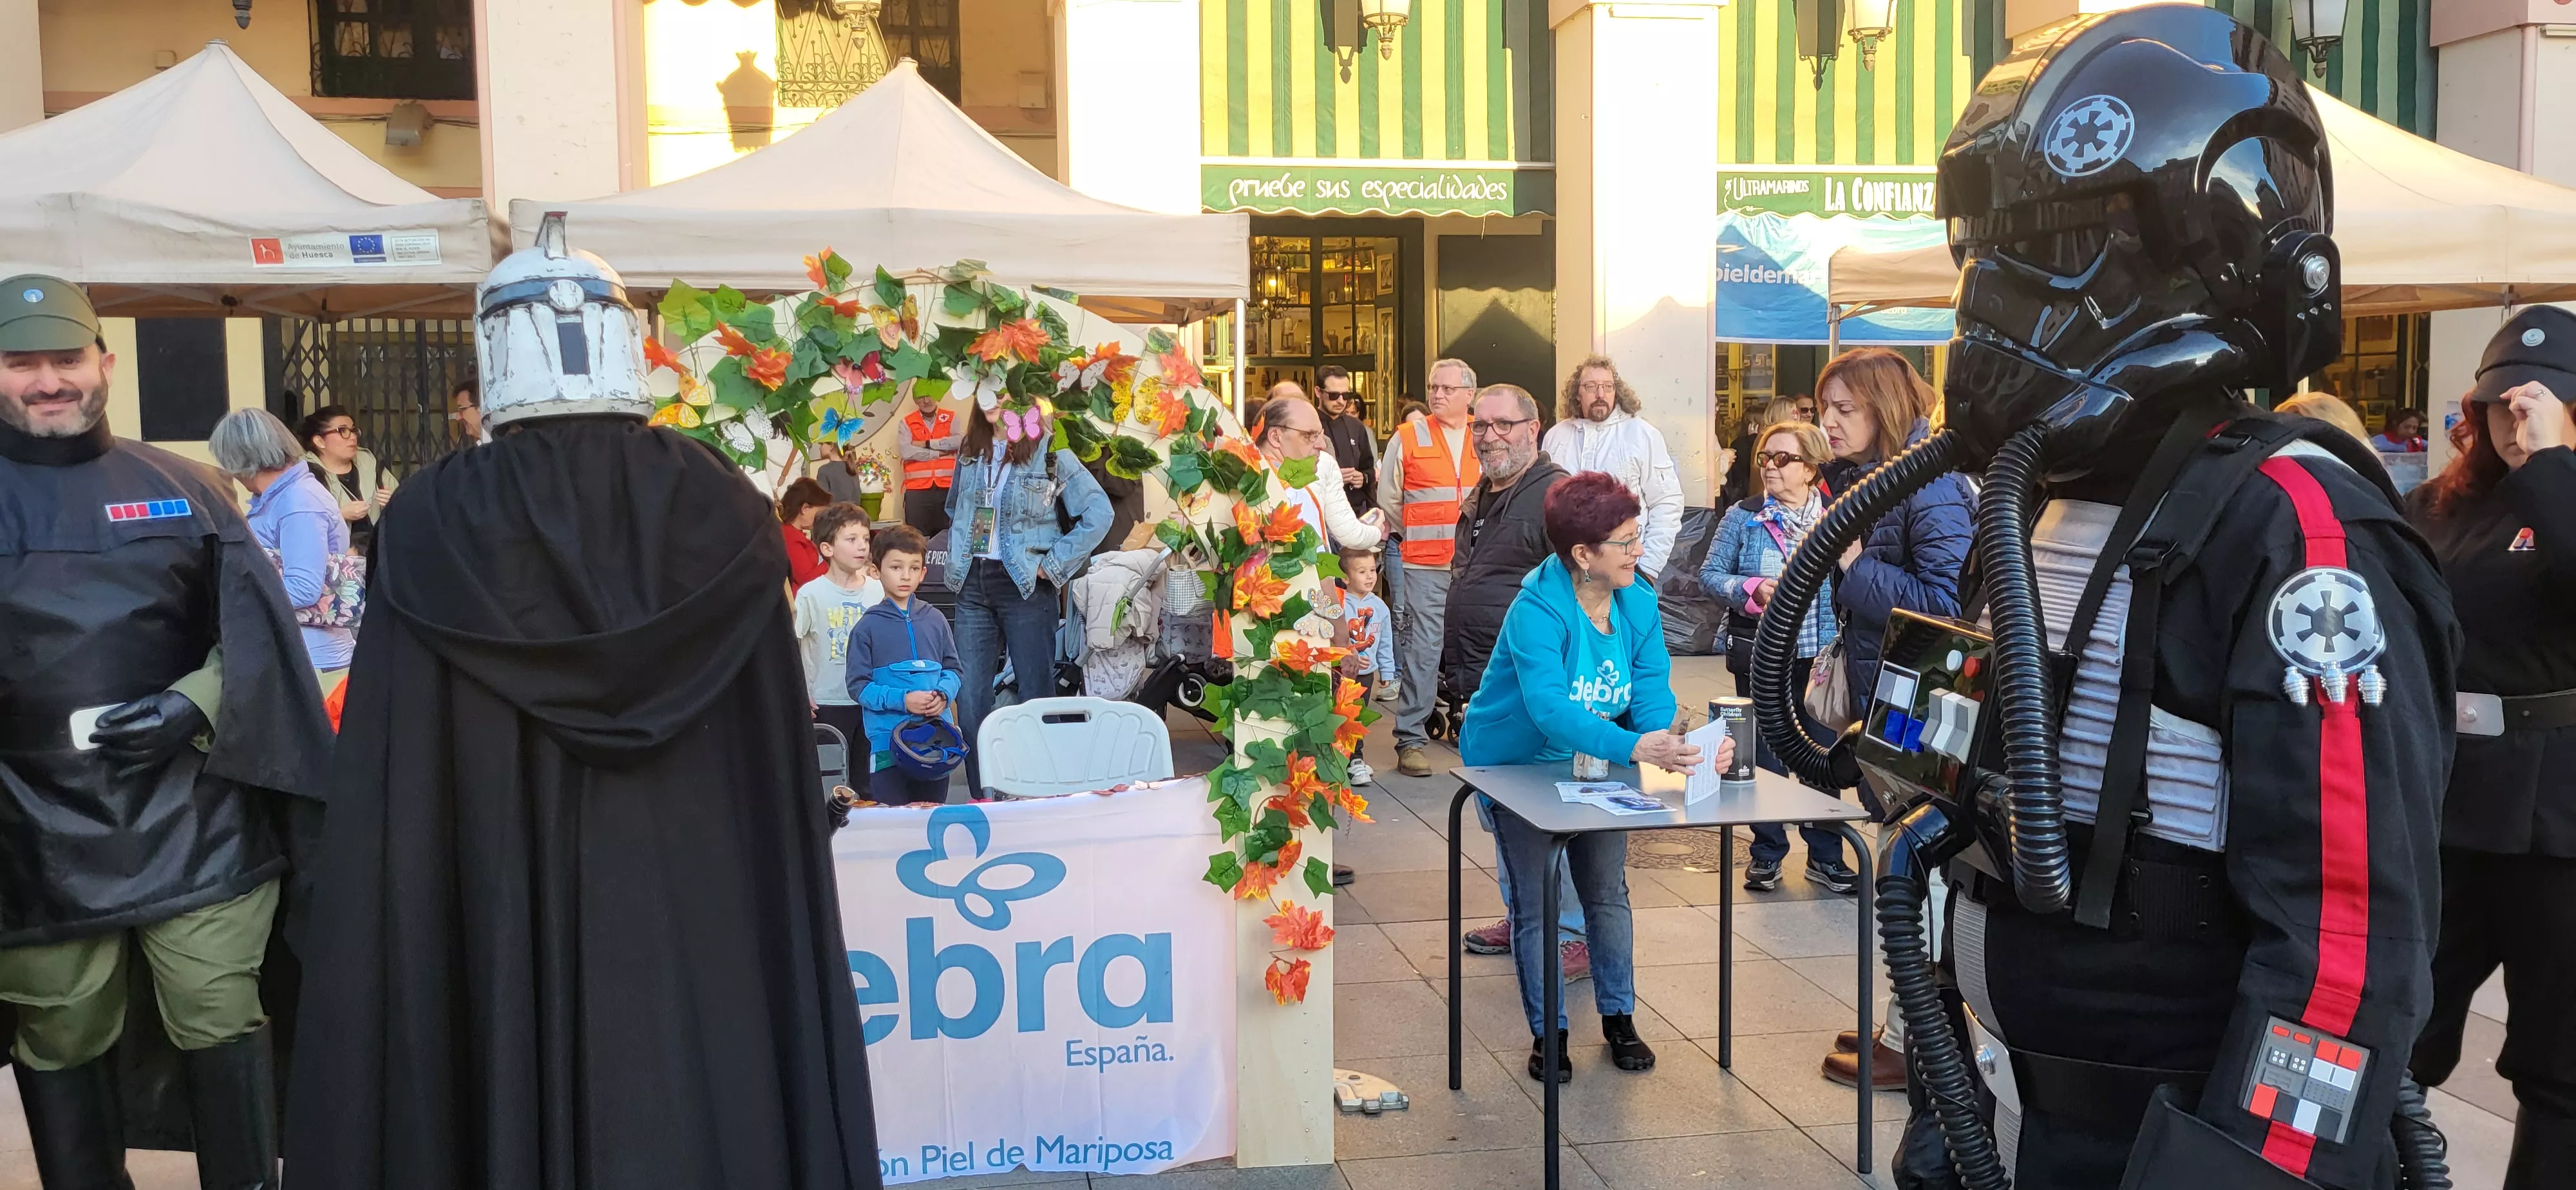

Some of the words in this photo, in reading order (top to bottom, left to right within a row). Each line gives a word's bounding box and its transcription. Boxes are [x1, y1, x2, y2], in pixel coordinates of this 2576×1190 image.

[1228, 172, 1306, 206] pruebe
[1316, 178, 1350, 199] sus
[1361, 175, 1508, 209] especialidades
[1824, 176, 1846, 211] LA
[1852, 176, 1934, 212] CONFIANZ
[288, 242, 345, 252] Ayuntamiento
[847, 916, 1173, 1046] ebra
[1066, 1035, 1175, 1073] España.
[921, 1141, 974, 1175] Piel
[986, 1138, 1025, 1167] de
[1036, 1135, 1175, 1171] Mariposa
